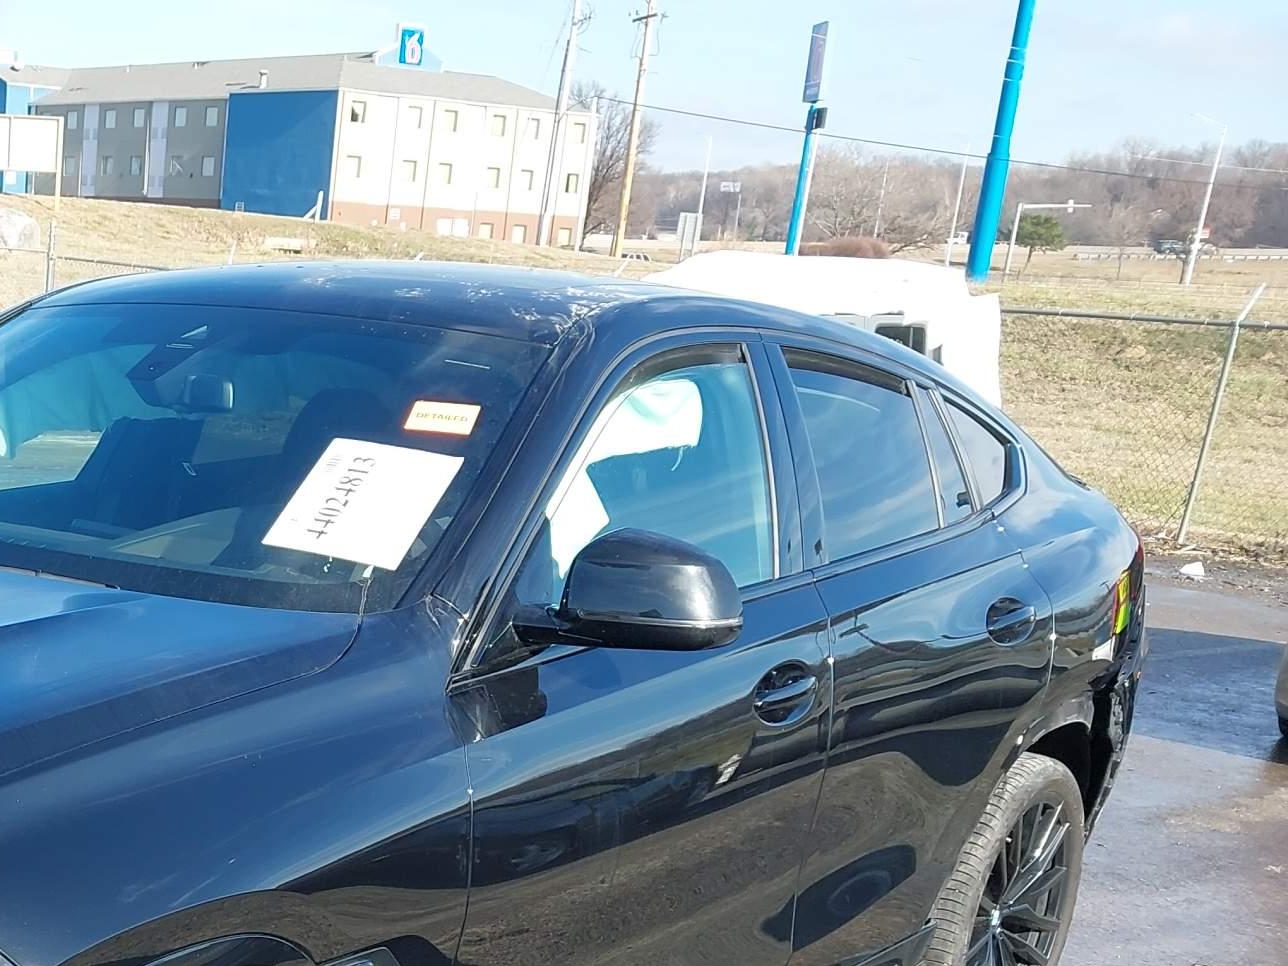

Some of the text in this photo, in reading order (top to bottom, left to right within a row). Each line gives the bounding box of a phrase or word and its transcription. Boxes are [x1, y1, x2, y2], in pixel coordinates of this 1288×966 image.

[405, 32, 422, 64] 6
[415, 411, 469, 423] DETAILED
[306, 456, 376, 540] 44024813
